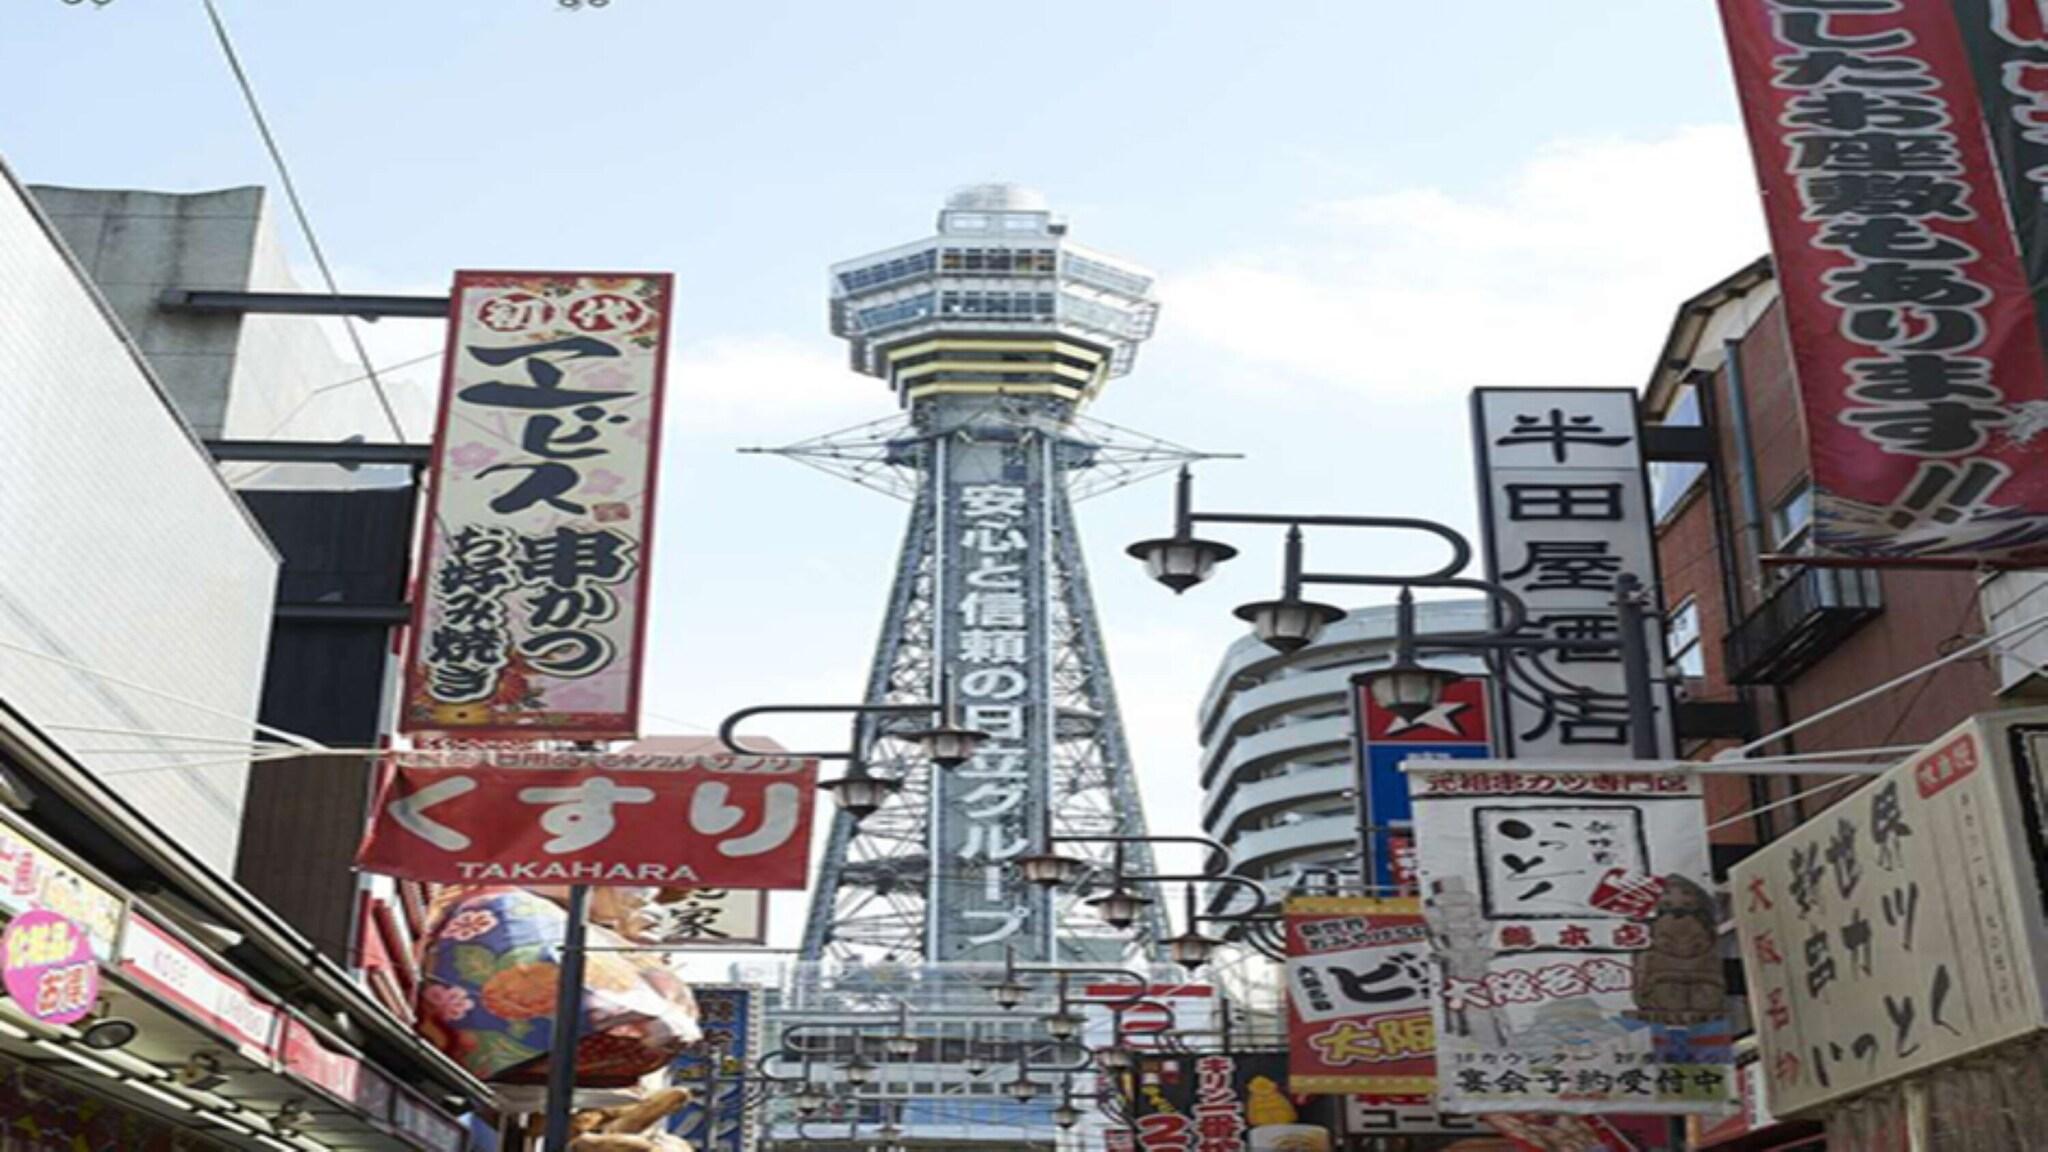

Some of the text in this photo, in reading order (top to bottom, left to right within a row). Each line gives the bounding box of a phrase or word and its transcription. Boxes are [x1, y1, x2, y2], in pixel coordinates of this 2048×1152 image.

[1770, 0, 2010, 531] したお座敷もあります!!
[424, 525, 514, 702] お好み焼き
[514, 526, 640, 679] 串かつ
[958, 484, 1029, 947] 安心と信頼の日立グループ
[388, 776, 800, 857] くすり
[455, 860, 699, 882] TAKAHARA
[1788, 780, 1912, 919] 新世界
[1327, 952, 1431, 1004] ビ
[1805, 881, 1919, 999] 串カツ
[1455, 1067, 1724, 1096] 宴会予約受付中
[1813, 964, 1962, 1088] いっとく
[1134, 1112, 1191, 1152] 2
[1362, 1109, 1484, 1129] コーヒ
